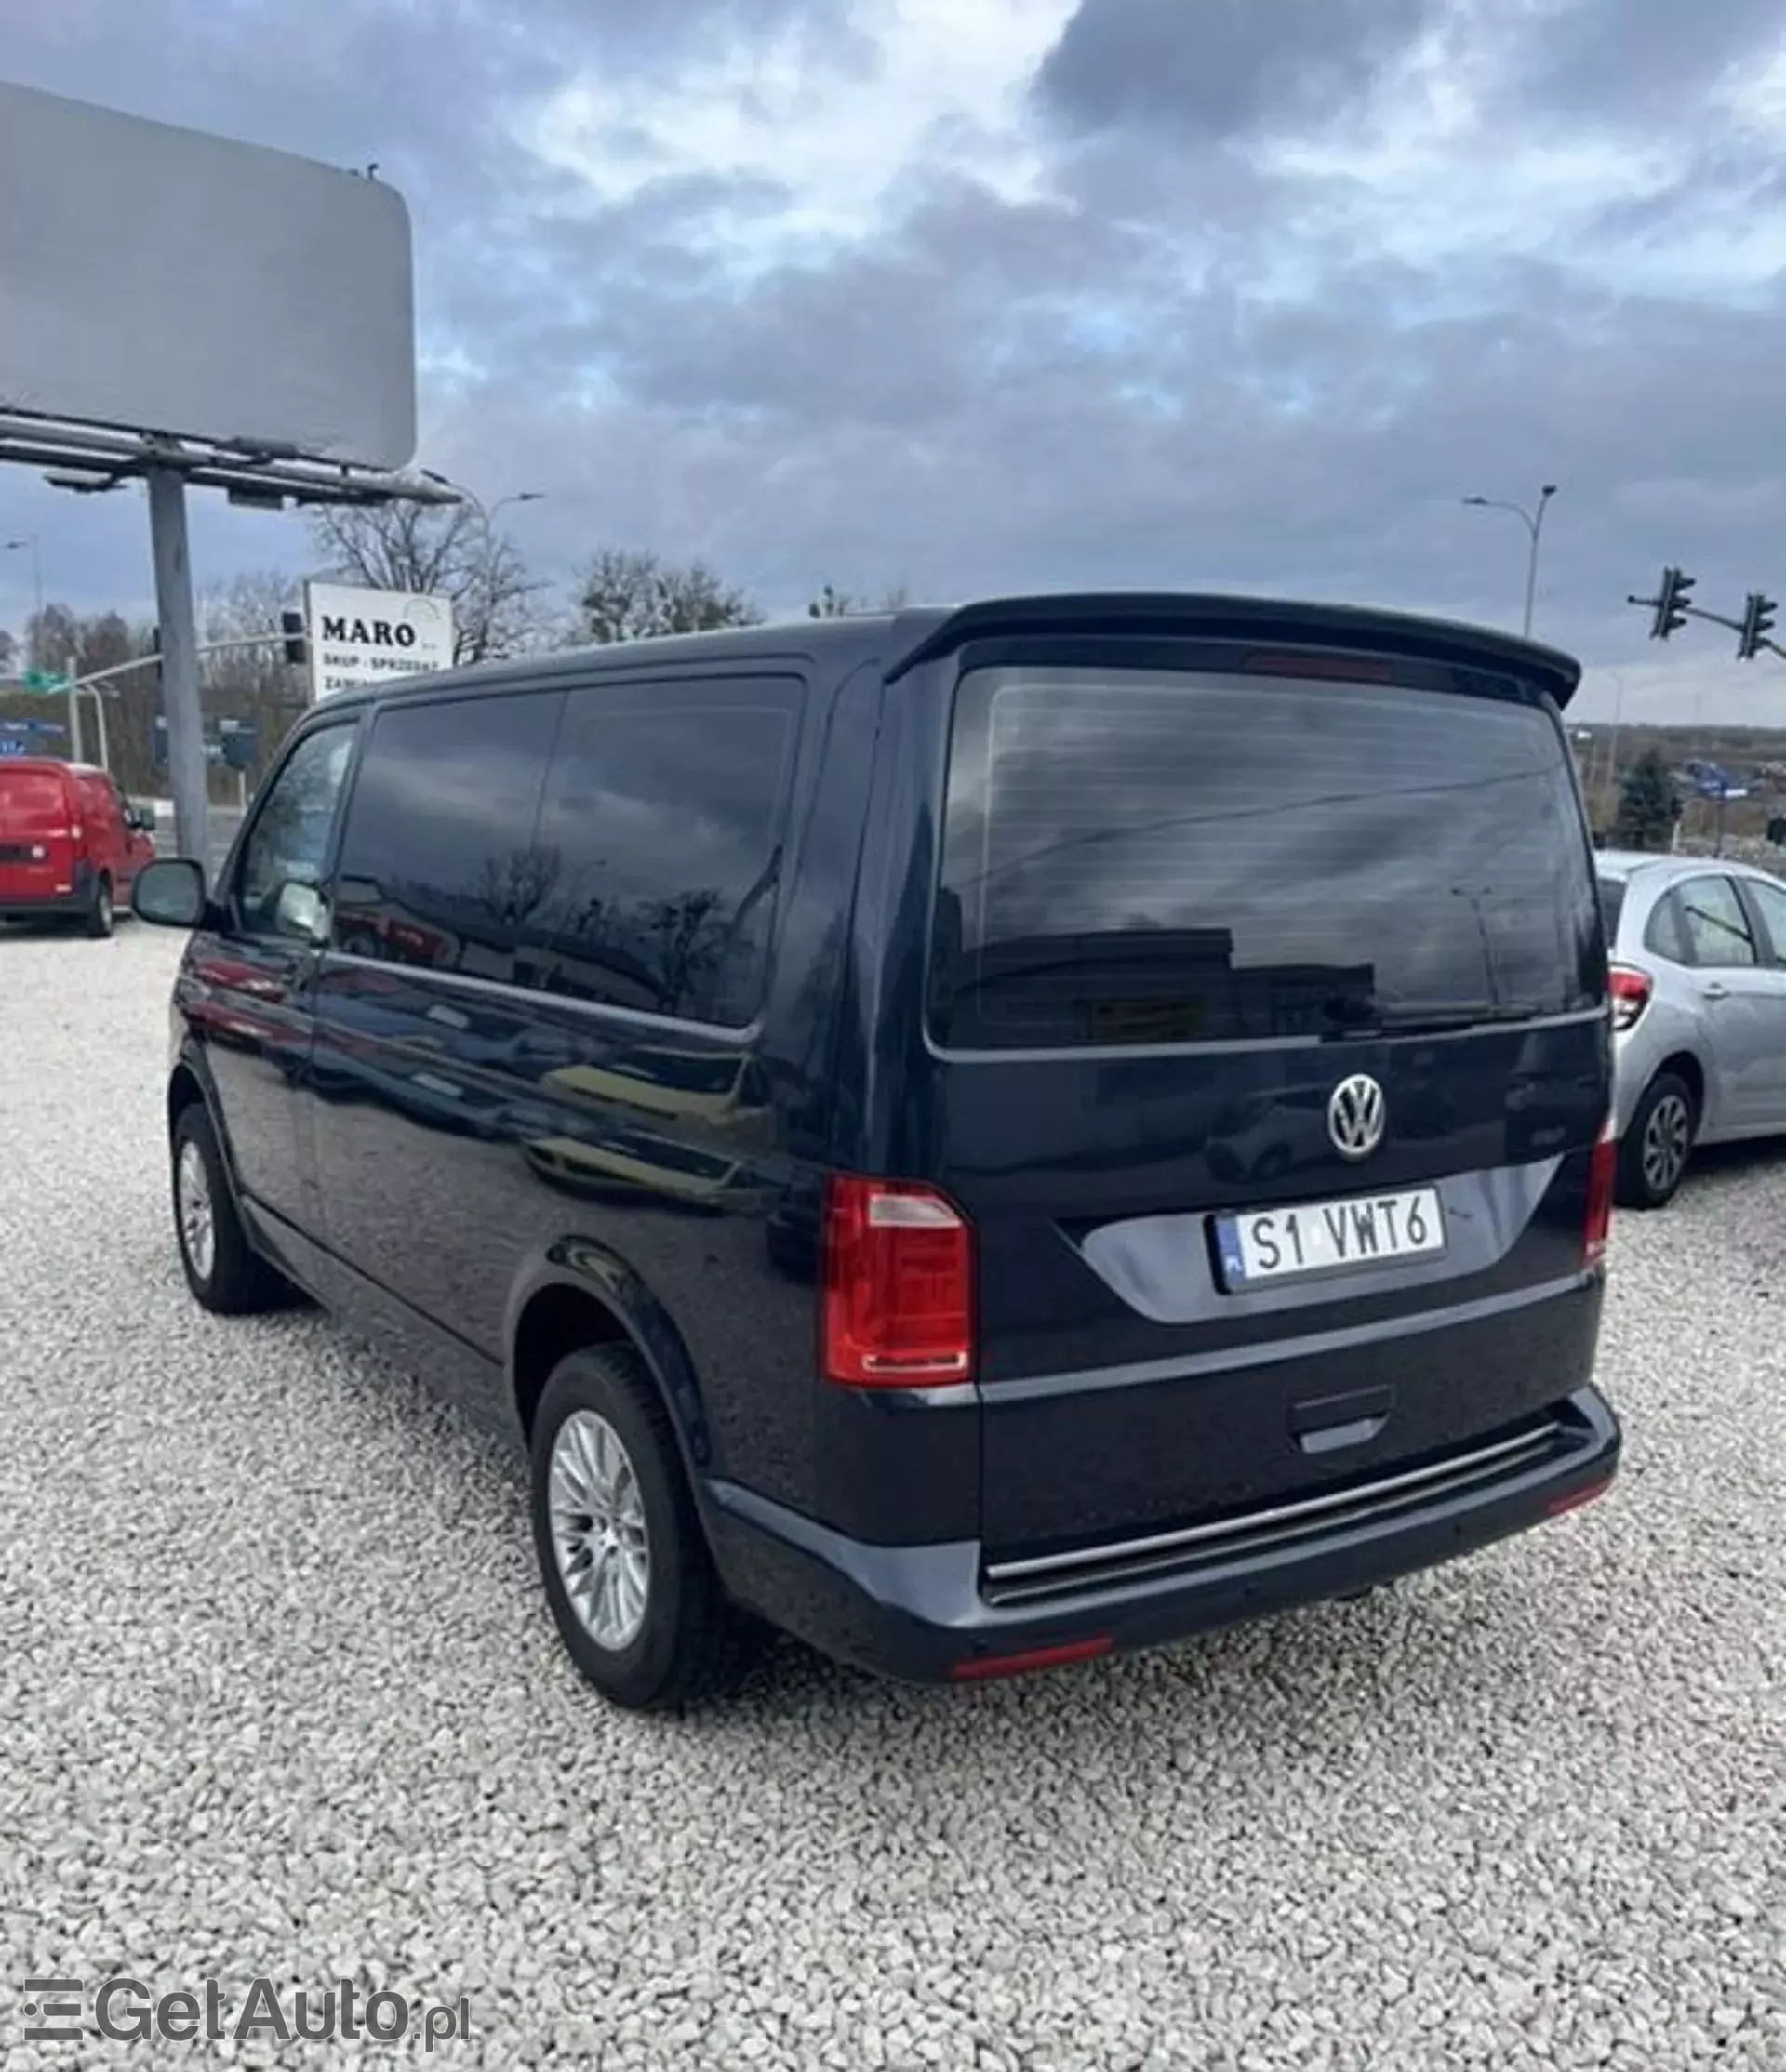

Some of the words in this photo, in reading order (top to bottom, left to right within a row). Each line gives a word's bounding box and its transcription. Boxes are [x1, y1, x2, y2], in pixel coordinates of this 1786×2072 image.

[322, 616, 416, 647] MARO
[1251, 1214, 1304, 1269] S1
[1323, 1195, 1427, 1258] VWT6
